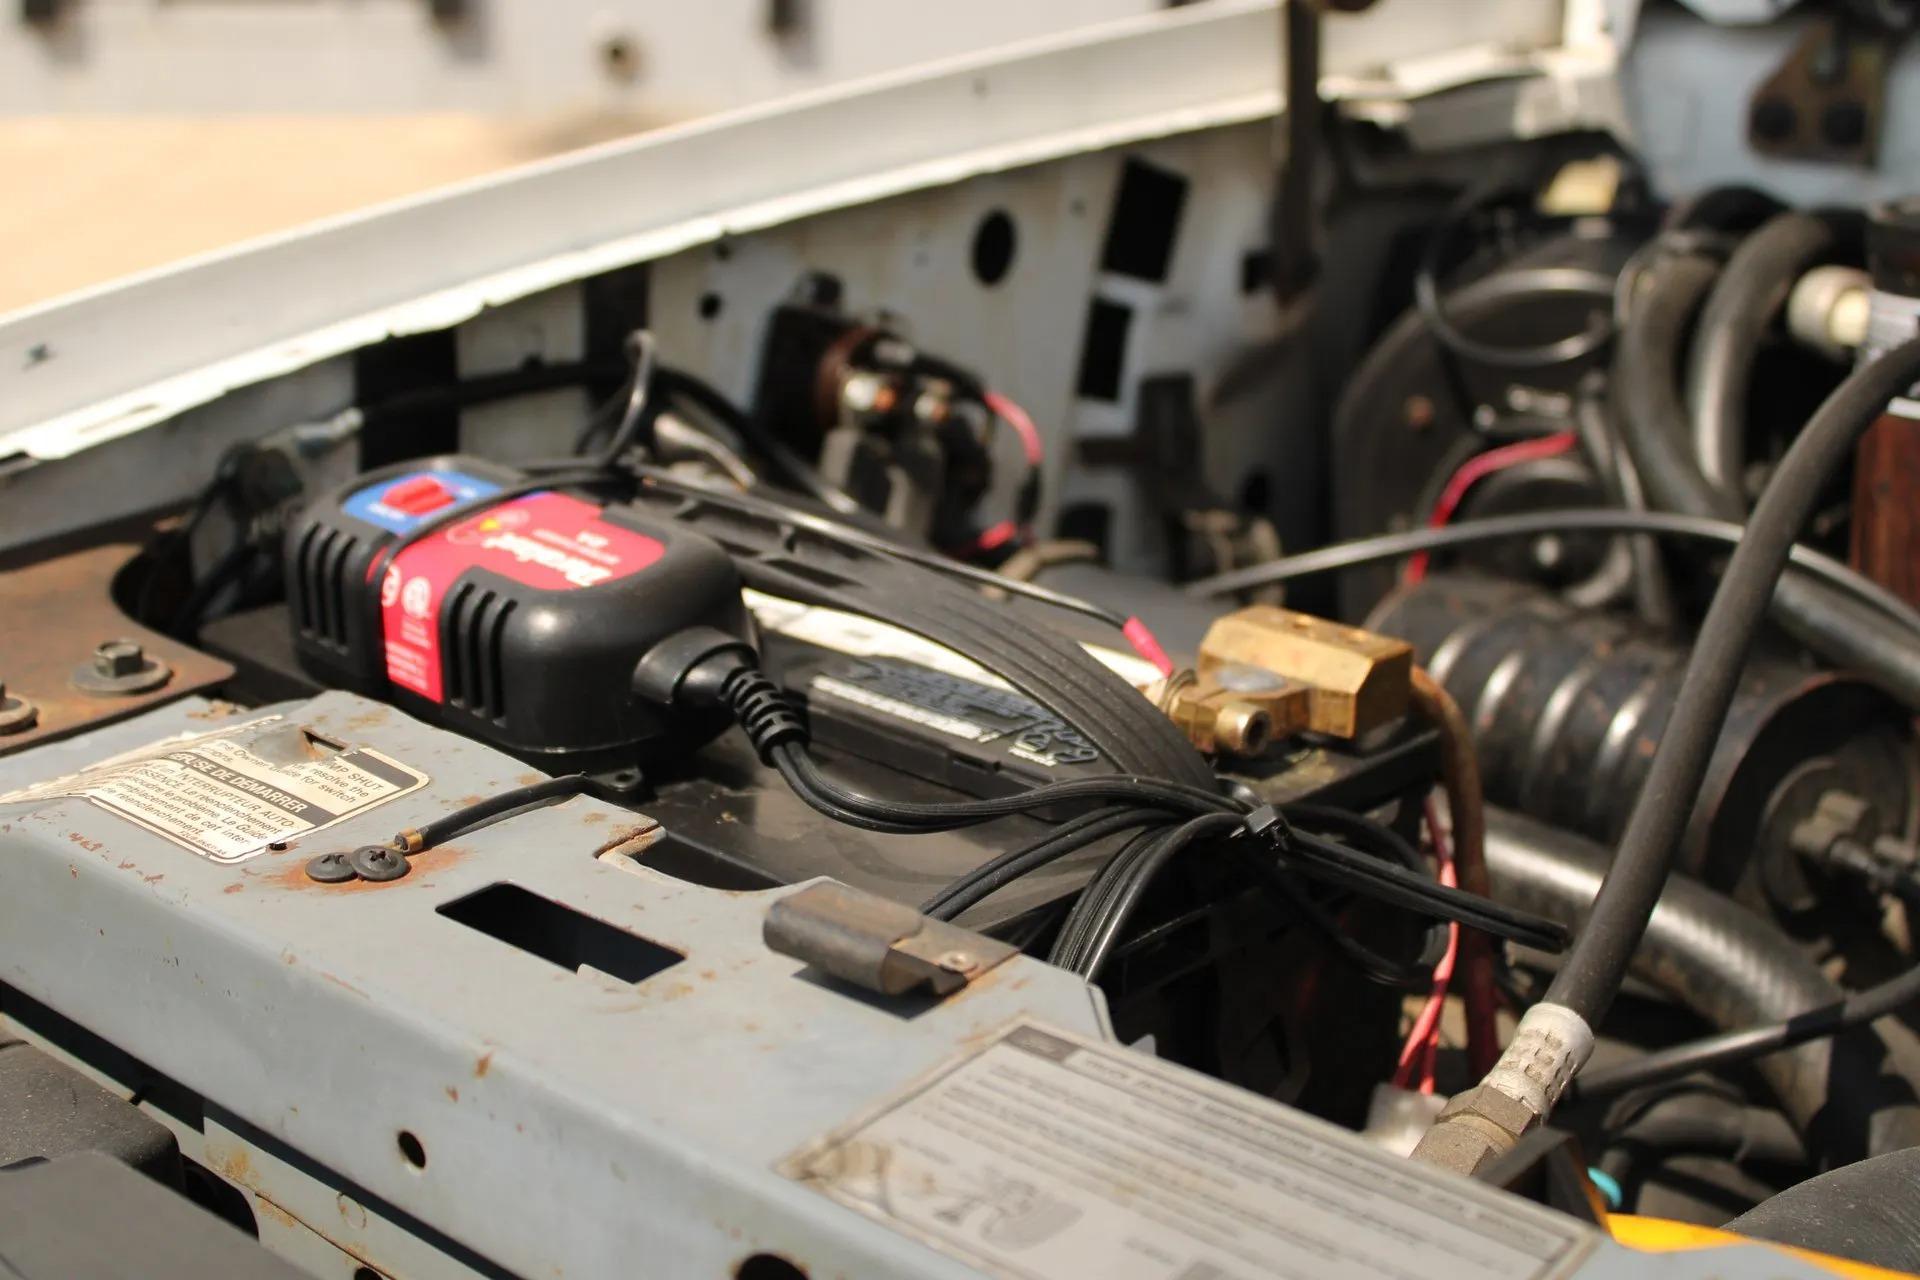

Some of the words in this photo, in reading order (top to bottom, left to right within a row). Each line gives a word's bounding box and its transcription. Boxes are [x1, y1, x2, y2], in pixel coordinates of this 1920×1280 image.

[177, 772, 261, 811] INTERRUPTEUR
[180, 786, 198, 796] Le
[209, 768, 235, 780] DE
[228, 776, 307, 812] DÉMARRER
[299, 774, 320, 785] for
[317, 783, 356, 803] switch
[309, 767, 349, 788] resolve
[348, 785, 369, 798] the
[183, 812, 201, 822] de
[200, 820, 222, 831] cet
[220, 815, 237, 826] Le
[234, 823, 268, 839] Guide
